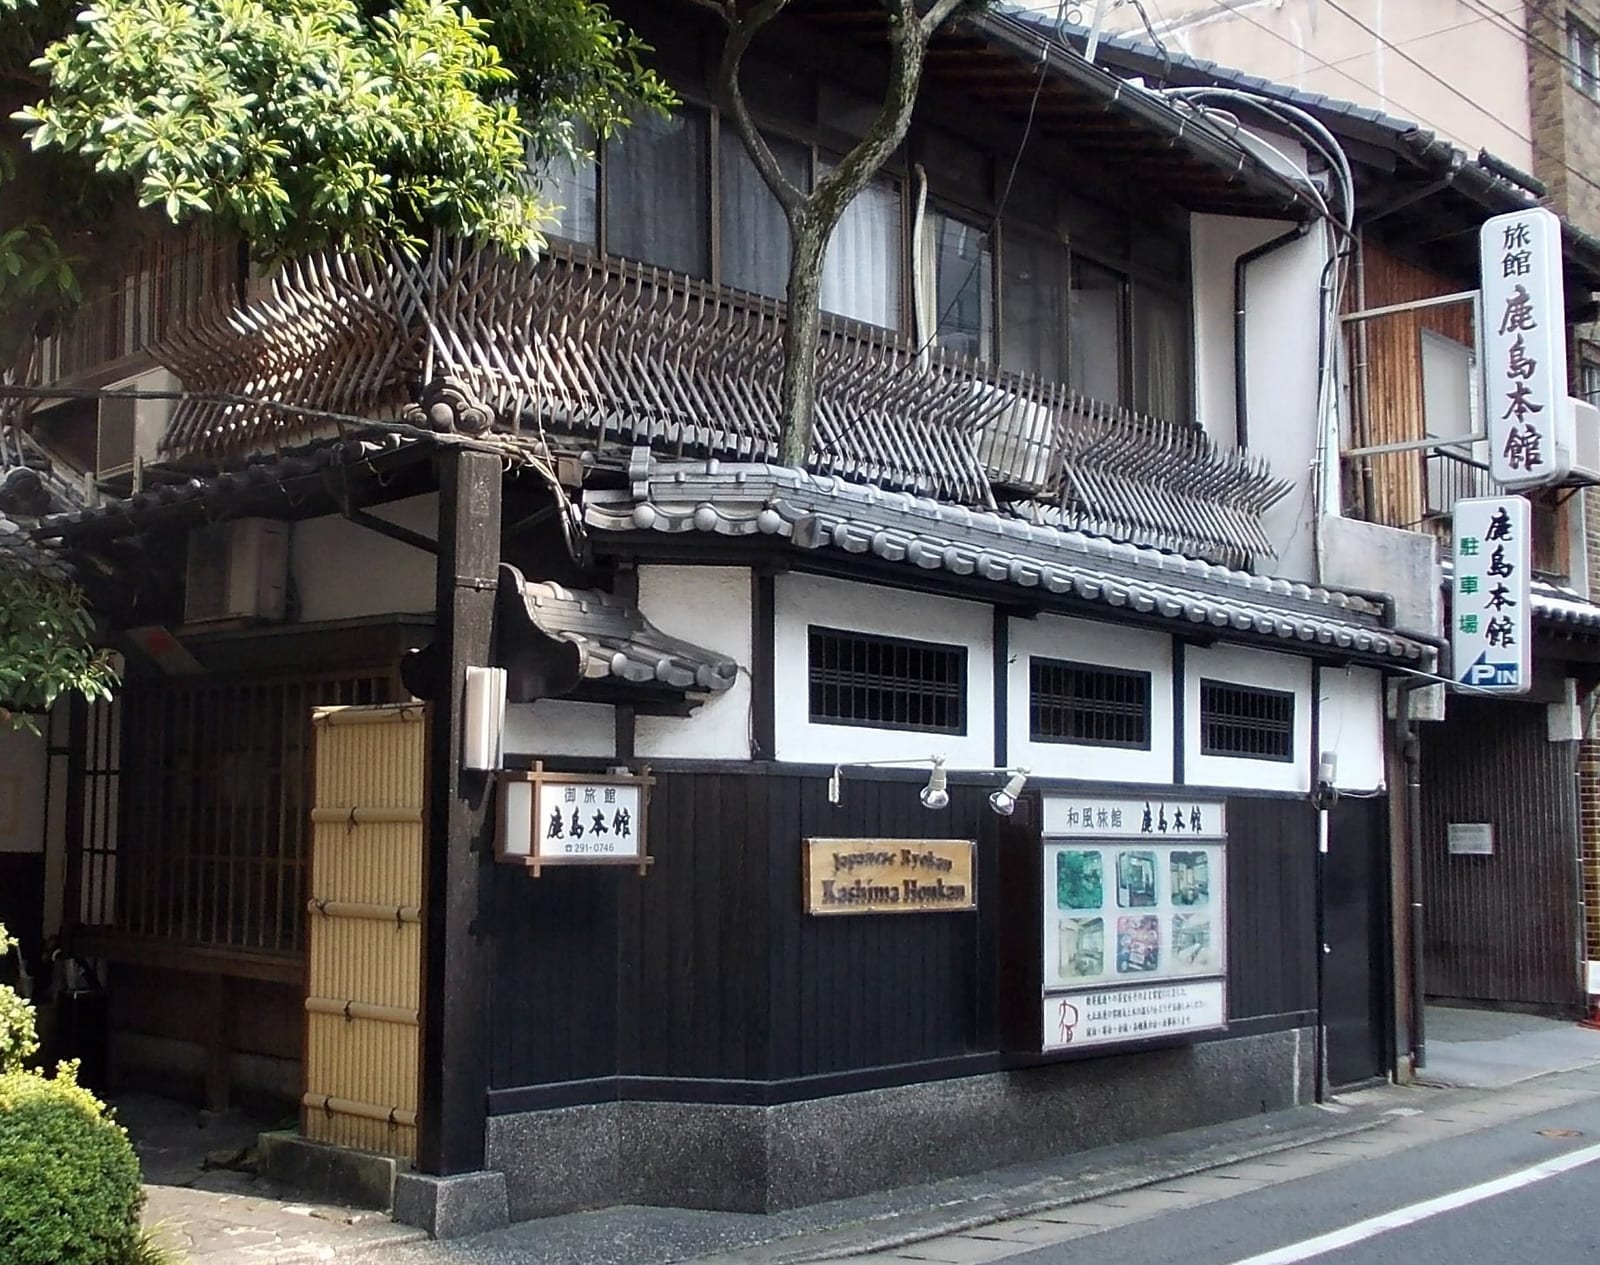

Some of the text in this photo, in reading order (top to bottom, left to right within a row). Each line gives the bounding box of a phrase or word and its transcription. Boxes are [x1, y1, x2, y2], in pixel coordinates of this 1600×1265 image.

[1498, 222, 1544, 471] 旅館 鹿島本館
[1459, 537, 1479, 634] 駐車場
[1484, 506, 1517, 649] 鹿島本館
[564, 787, 617, 804] 御旅館
[546, 805, 632, 840] 鹿島本館
[1066, 801, 1203, 835] 和風旅館 鹿島本館
[821, 879, 900, 904] Kashima
